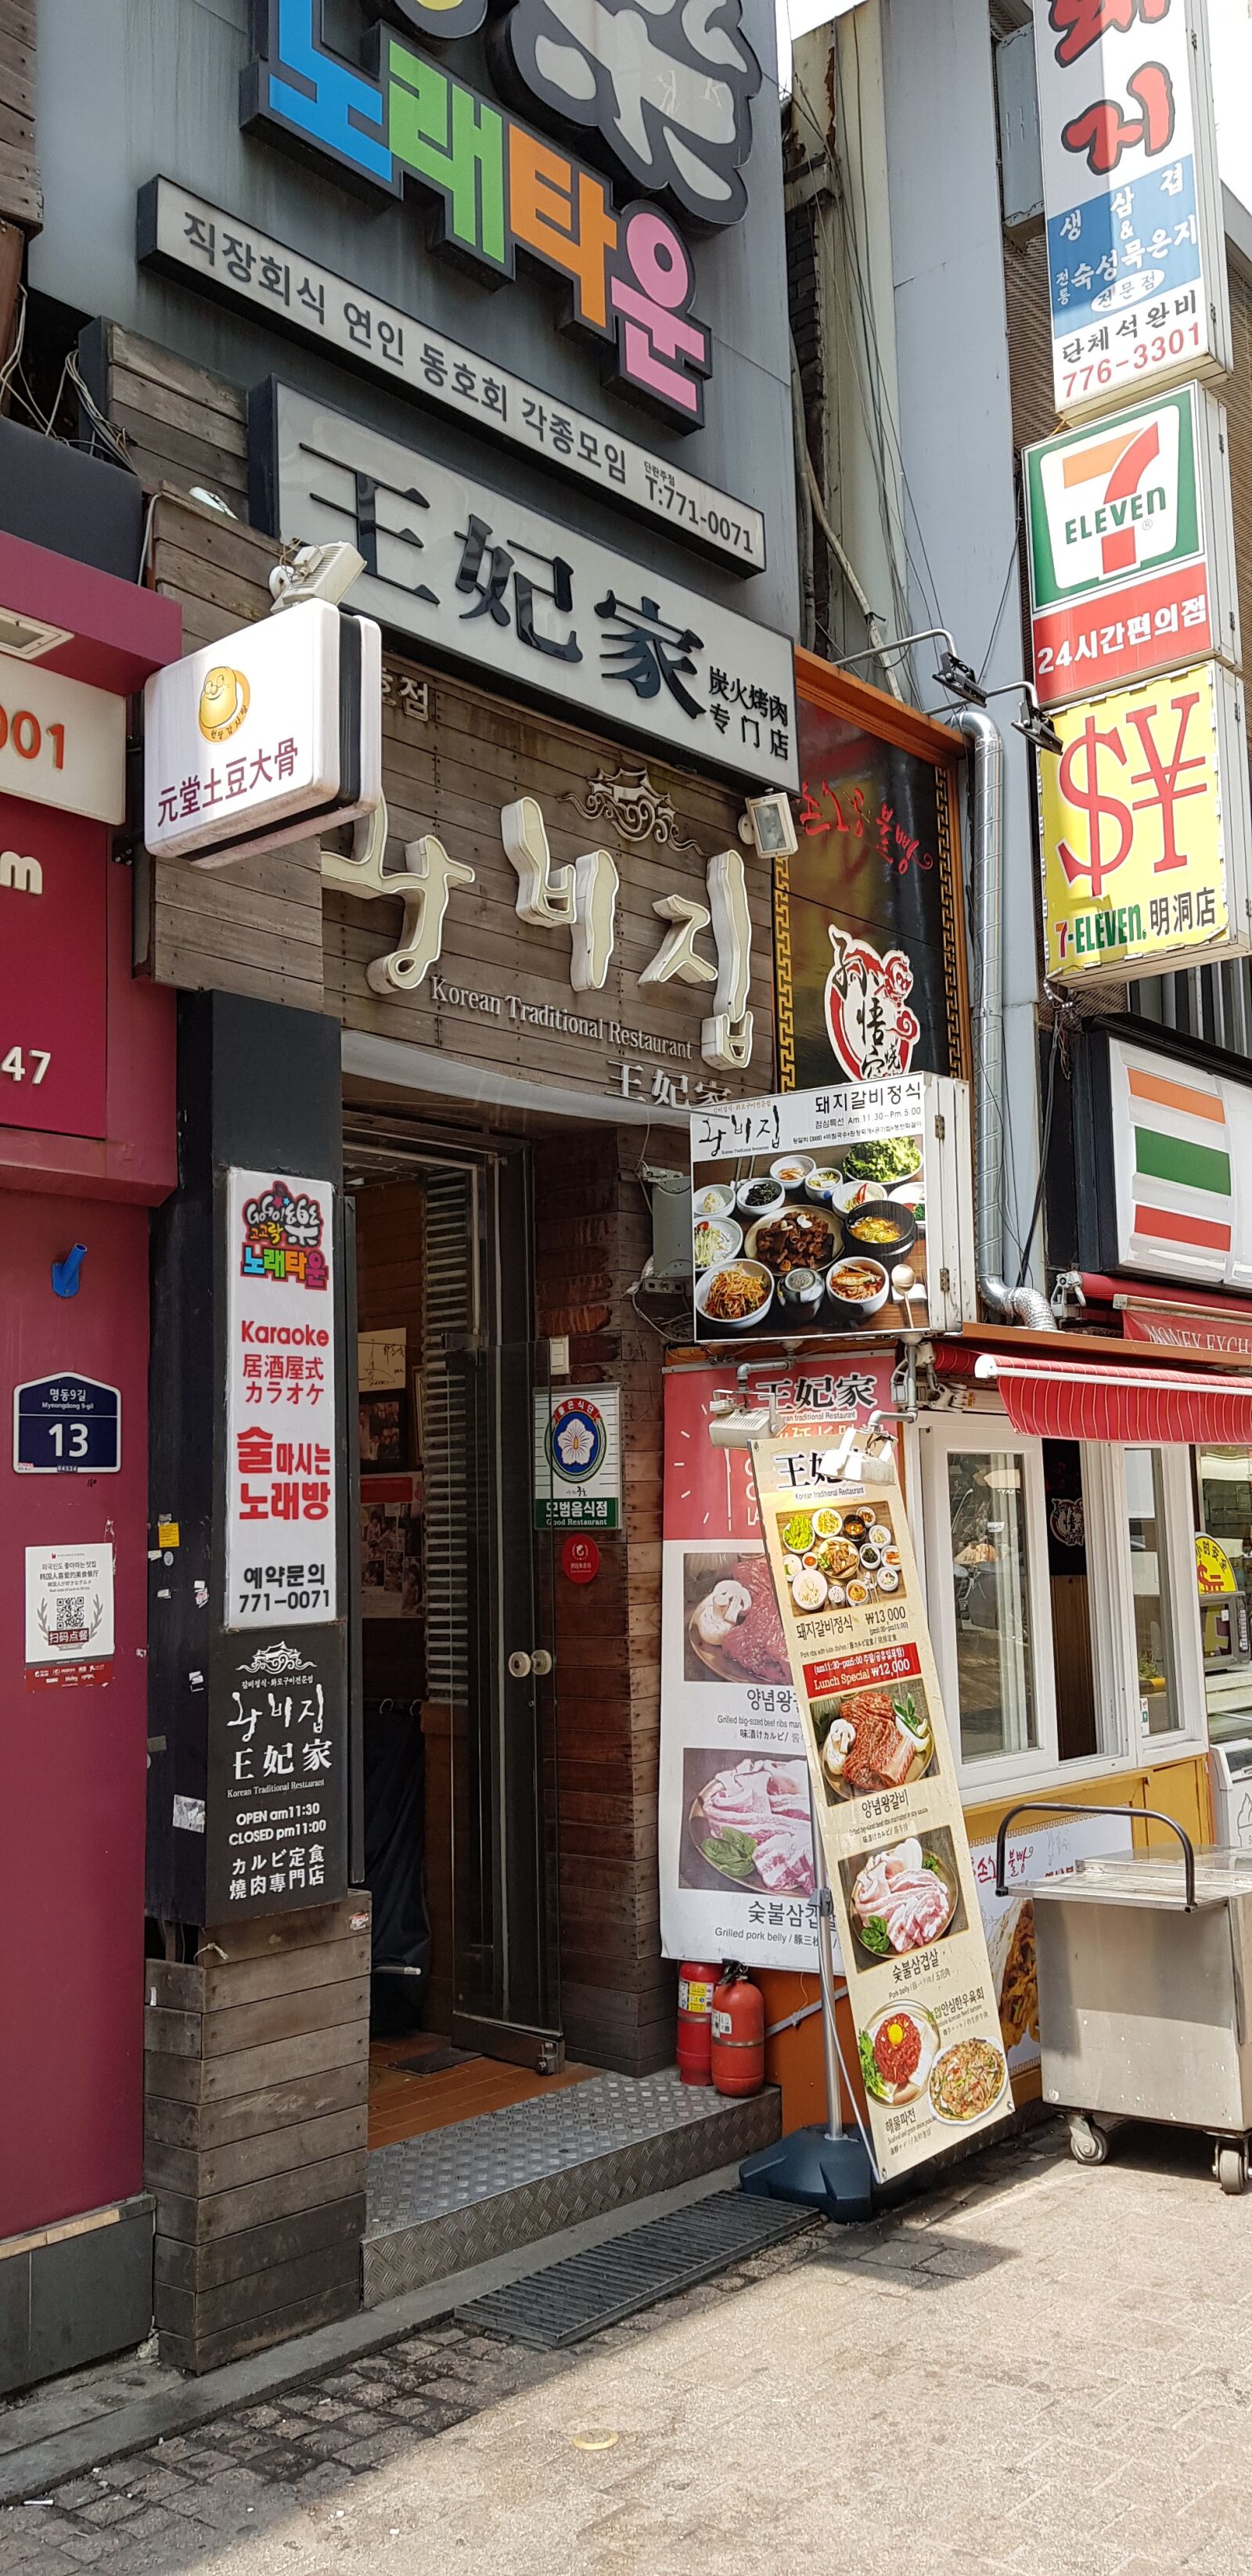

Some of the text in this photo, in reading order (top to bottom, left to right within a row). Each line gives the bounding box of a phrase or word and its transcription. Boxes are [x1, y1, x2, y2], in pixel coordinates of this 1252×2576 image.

[269, 0, 704, 413] 노래타운
[1071, 214, 1197, 290] 숙성묵은지
[1056, 268, 1071, 306] 전통
[1098, 271, 1157, 308] 전문점
[183, 211, 627, 485] 직장회식 연인 동호회 각종모임
[1063, 322, 1200, 397] 776-3301
[643, 460, 676, 487] 단란주점
[645, 474, 754, 554] T:771-0071
[299, 442, 707, 719] 王妃家
[1037, 593, 1207, 676] 24시간편의점
[708, 665, 789, 726] 炭火烤肉
[157, 737, 298, 827] 元堂土豆大骨
[1149, 886, 1215, 937] 明洞店
[431, 977, 693, 1061] Korean Traditional Restaurant
[0, 1046, 51, 1084] 47
[815, 1082, 921, 1115] 돼지갈비정식
[698, 1104, 780, 1157] 왕비집
[243, 1246, 326, 1287] 노래타운
[241, 1320, 329, 1348] Karaoke
[243, 1354, 324, 1382] 居酒屋式
[49, 1388, 86, 1402] 명동9길
[245, 1382, 325, 1406] カラオケ
[756, 1374, 875, 1410] 王妃家
[49, 1423, 88, 1457] 13
[239, 1482, 331, 1521] 노래방
[545, 1501, 608, 1518] 모범음식점
[795, 1486, 865, 1501] Korean traditional Restaurant
[243, 1563, 326, 1590] 예약문의
[239, 1590, 329, 1613] 771-0071
[865, 1605, 906, 1626] ₩13,000
[49, 1630, 88, 1644] 扫码点餐
[796, 1614, 854, 1641] 돼지갈비정식
[814, 1658, 910, 1691] Lunch Special ₩12,000
[227, 1684, 324, 1742] 왕비집
[718, 1715, 738, 1724] Grilled
[232, 1738, 333, 1781] 王妃家
[227, 1789, 252, 1799] Korean
[253, 1782, 290, 1795] Traditional
[862, 1789, 909, 1818] 양념왕갈비
[236, 1802, 320, 1826] OPEN am11:30
[228, 1818, 326, 1846] CLOSED pm11:00
[232, 1843, 325, 1876] カルビ定食
[229, 1864, 325, 1900] 燒肉專門店
[714, 1927, 743, 1938] Grilled
[746, 1930, 765, 1941] pork
[767, 1931, 787, 1944] belly
[892, 1948, 939, 1983] 숯불삼겹살
[885, 2107, 917, 2134] 해물파전
